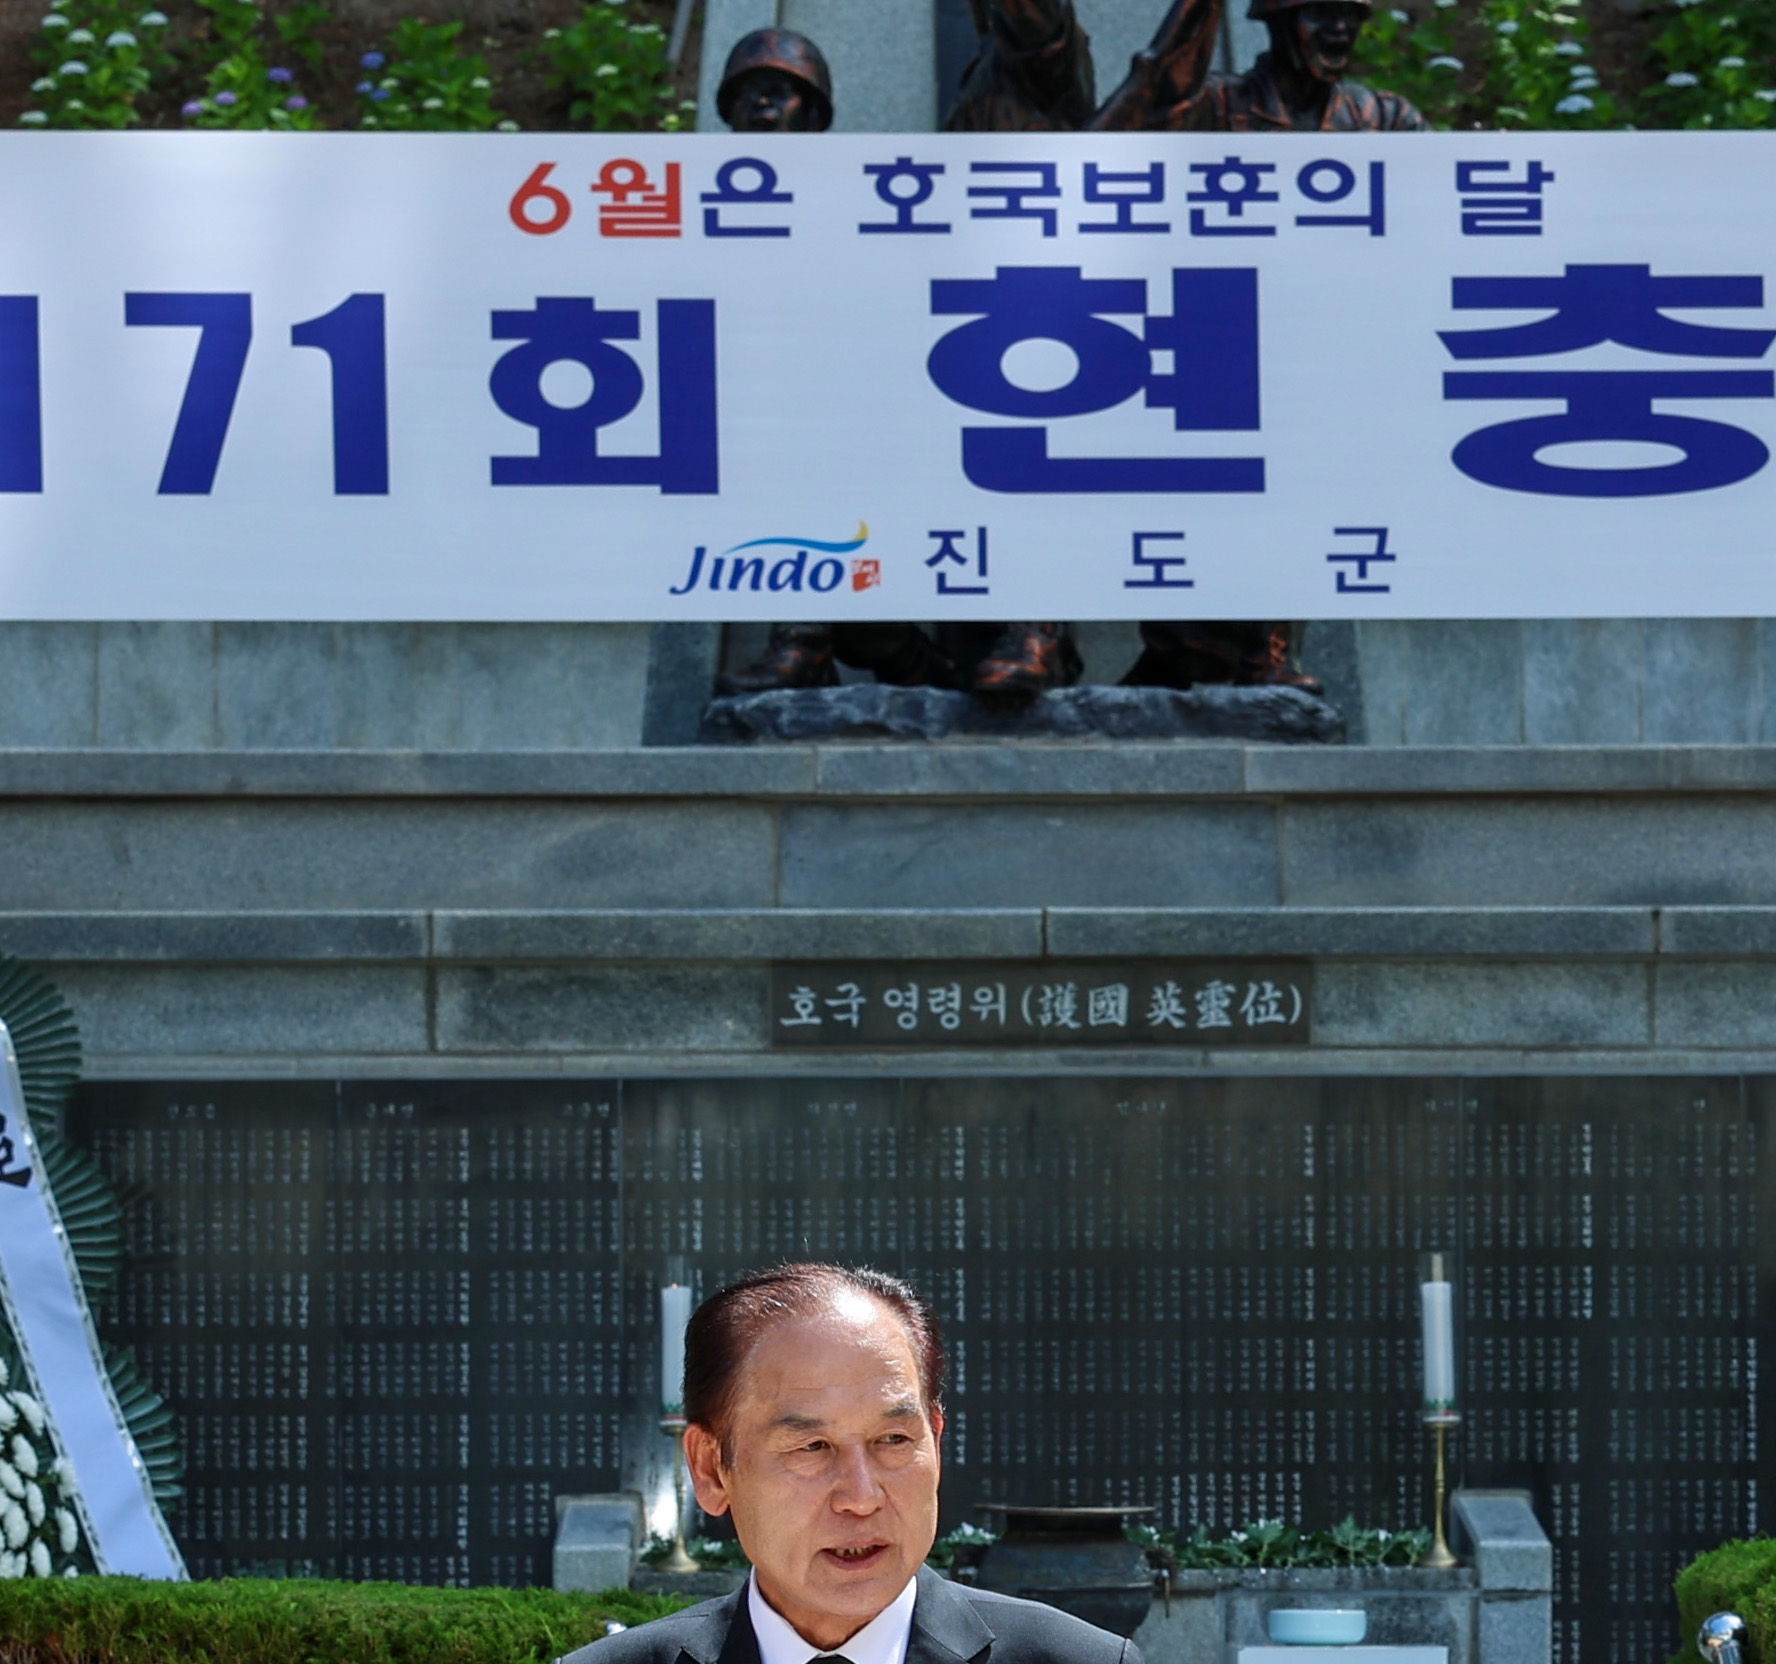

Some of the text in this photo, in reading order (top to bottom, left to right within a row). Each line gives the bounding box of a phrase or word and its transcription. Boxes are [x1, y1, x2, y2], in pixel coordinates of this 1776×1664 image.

[510, 156, 1555, 237] 6월은 호국보훈의 달
[669, 545, 845, 595] Jindo
[779, 982, 867, 1028] 호국
